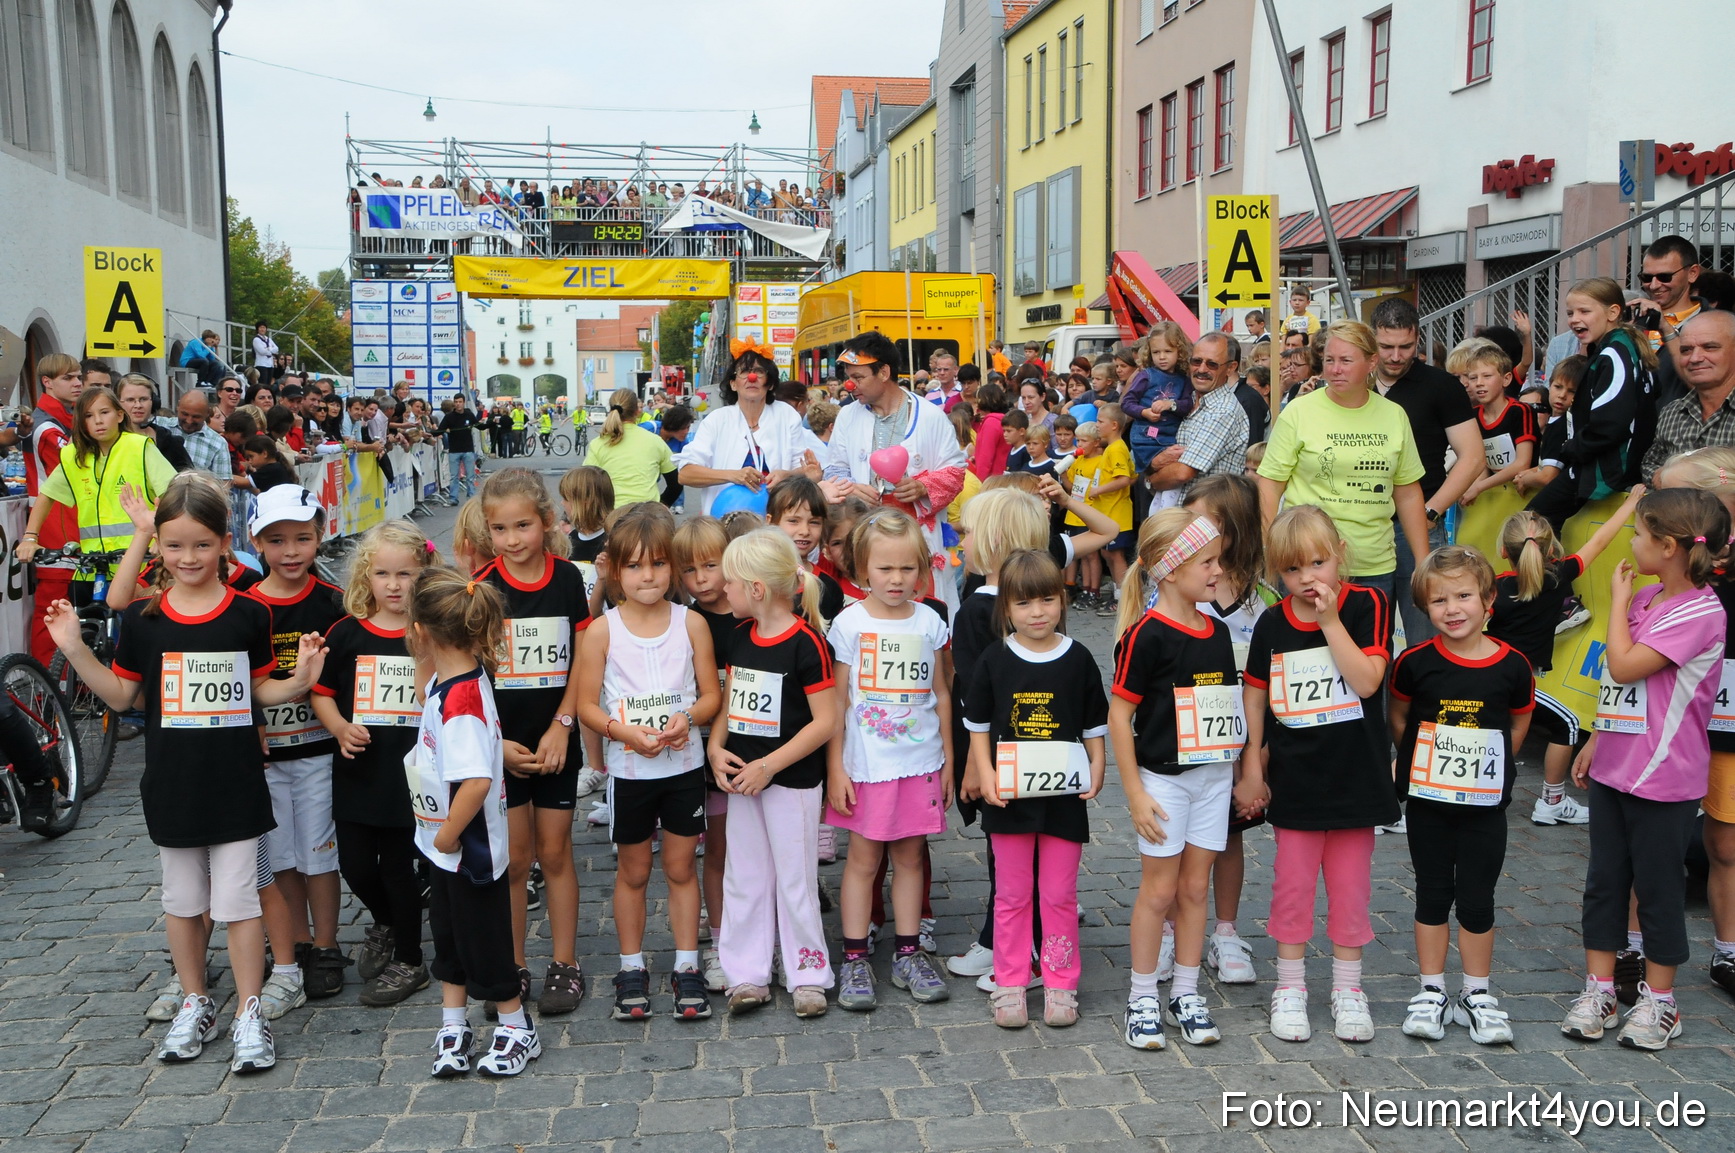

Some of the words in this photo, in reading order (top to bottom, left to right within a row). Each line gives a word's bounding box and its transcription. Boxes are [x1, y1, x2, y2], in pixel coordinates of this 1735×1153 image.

[1482, 154, 1556, 199] Döpfer
[1216, 200, 1270, 220] Block
[594, 225, 642, 241] 13:42:29
[1479, 236, 1493, 248] BABY
[1494, 236, 1499, 245] &
[1500, 229, 1547, 245] KINDERMODEN
[1222, 229, 1263, 283] A
[1413, 246, 1439, 258] GARDINEN
[94, 251, 154, 273] Block
[563, 267, 625, 288] ZIEL
[927, 289, 978, 298] Schnupper-
[103, 281, 148, 334] A
[944, 300, 961, 309] lauf
[1326, 433, 1389, 442] NEUMARKTER
[1485, 450, 1510, 466] 7187
[516, 624, 538, 637] Lisa
[518, 643, 568, 665] 7154
[881, 638, 900, 652] Eva
[187, 659, 234, 673] Victoria
[734, 667, 755, 683] Melina
[882, 661, 929, 681] 7159
[1292, 661, 1329, 676] Lucy
[188, 681, 244, 703] 7099
[1290, 674, 1347, 703] 7271
[627, 693, 682, 711] Magdalena
[731, 688, 772, 713] 7182
[1196, 695, 1239, 710] Victoria
[1440, 699, 1484, 708] NEUMARKTER
[1443, 705, 1480, 713] STADTLAUF
[1018, 721, 1060, 729] BAMBINILAUF
[1202, 715, 1243, 738] 7270
[1434, 733, 1500, 757] Katharina
[1438, 755, 1496, 780] 7314
[1023, 771, 1082, 792] 7224
